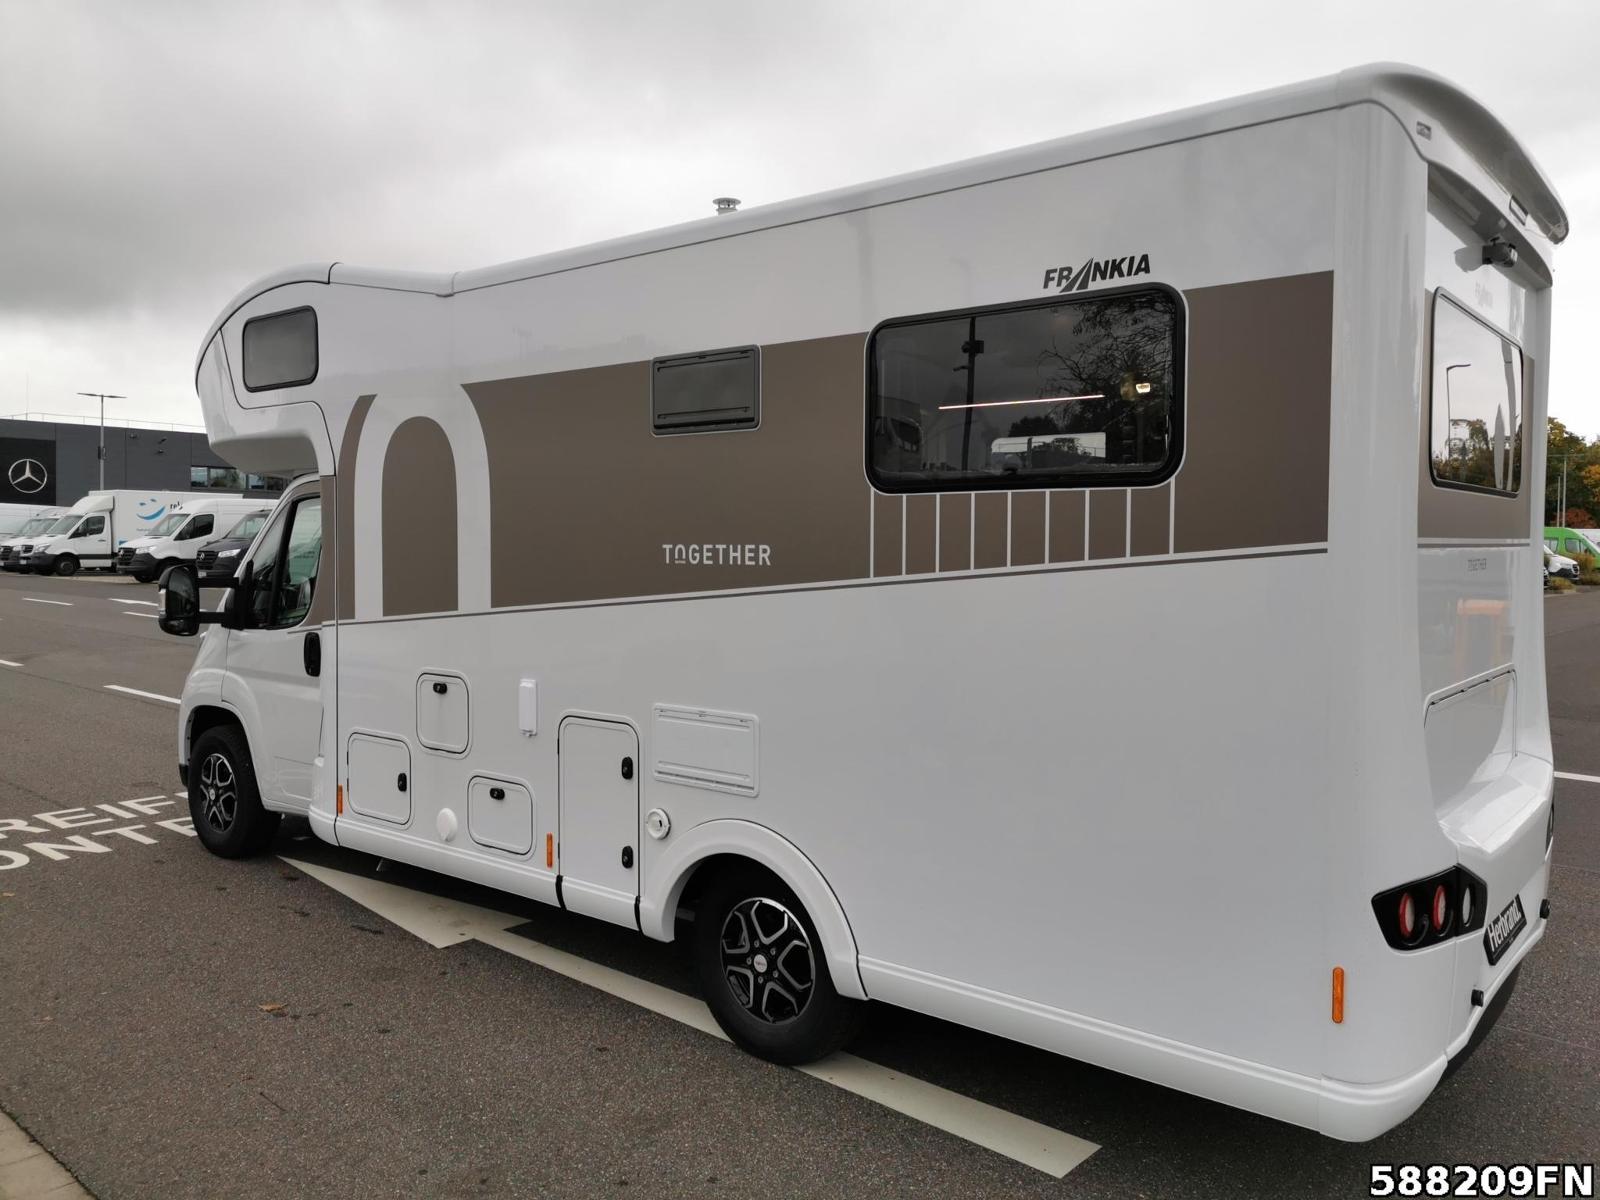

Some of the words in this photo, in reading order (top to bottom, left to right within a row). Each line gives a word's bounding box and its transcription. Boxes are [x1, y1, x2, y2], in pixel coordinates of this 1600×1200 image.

[1043, 253, 1151, 294] FRANKIA
[662, 543, 772, 566] TOGETHER
[0, 792, 188, 838] REIF
